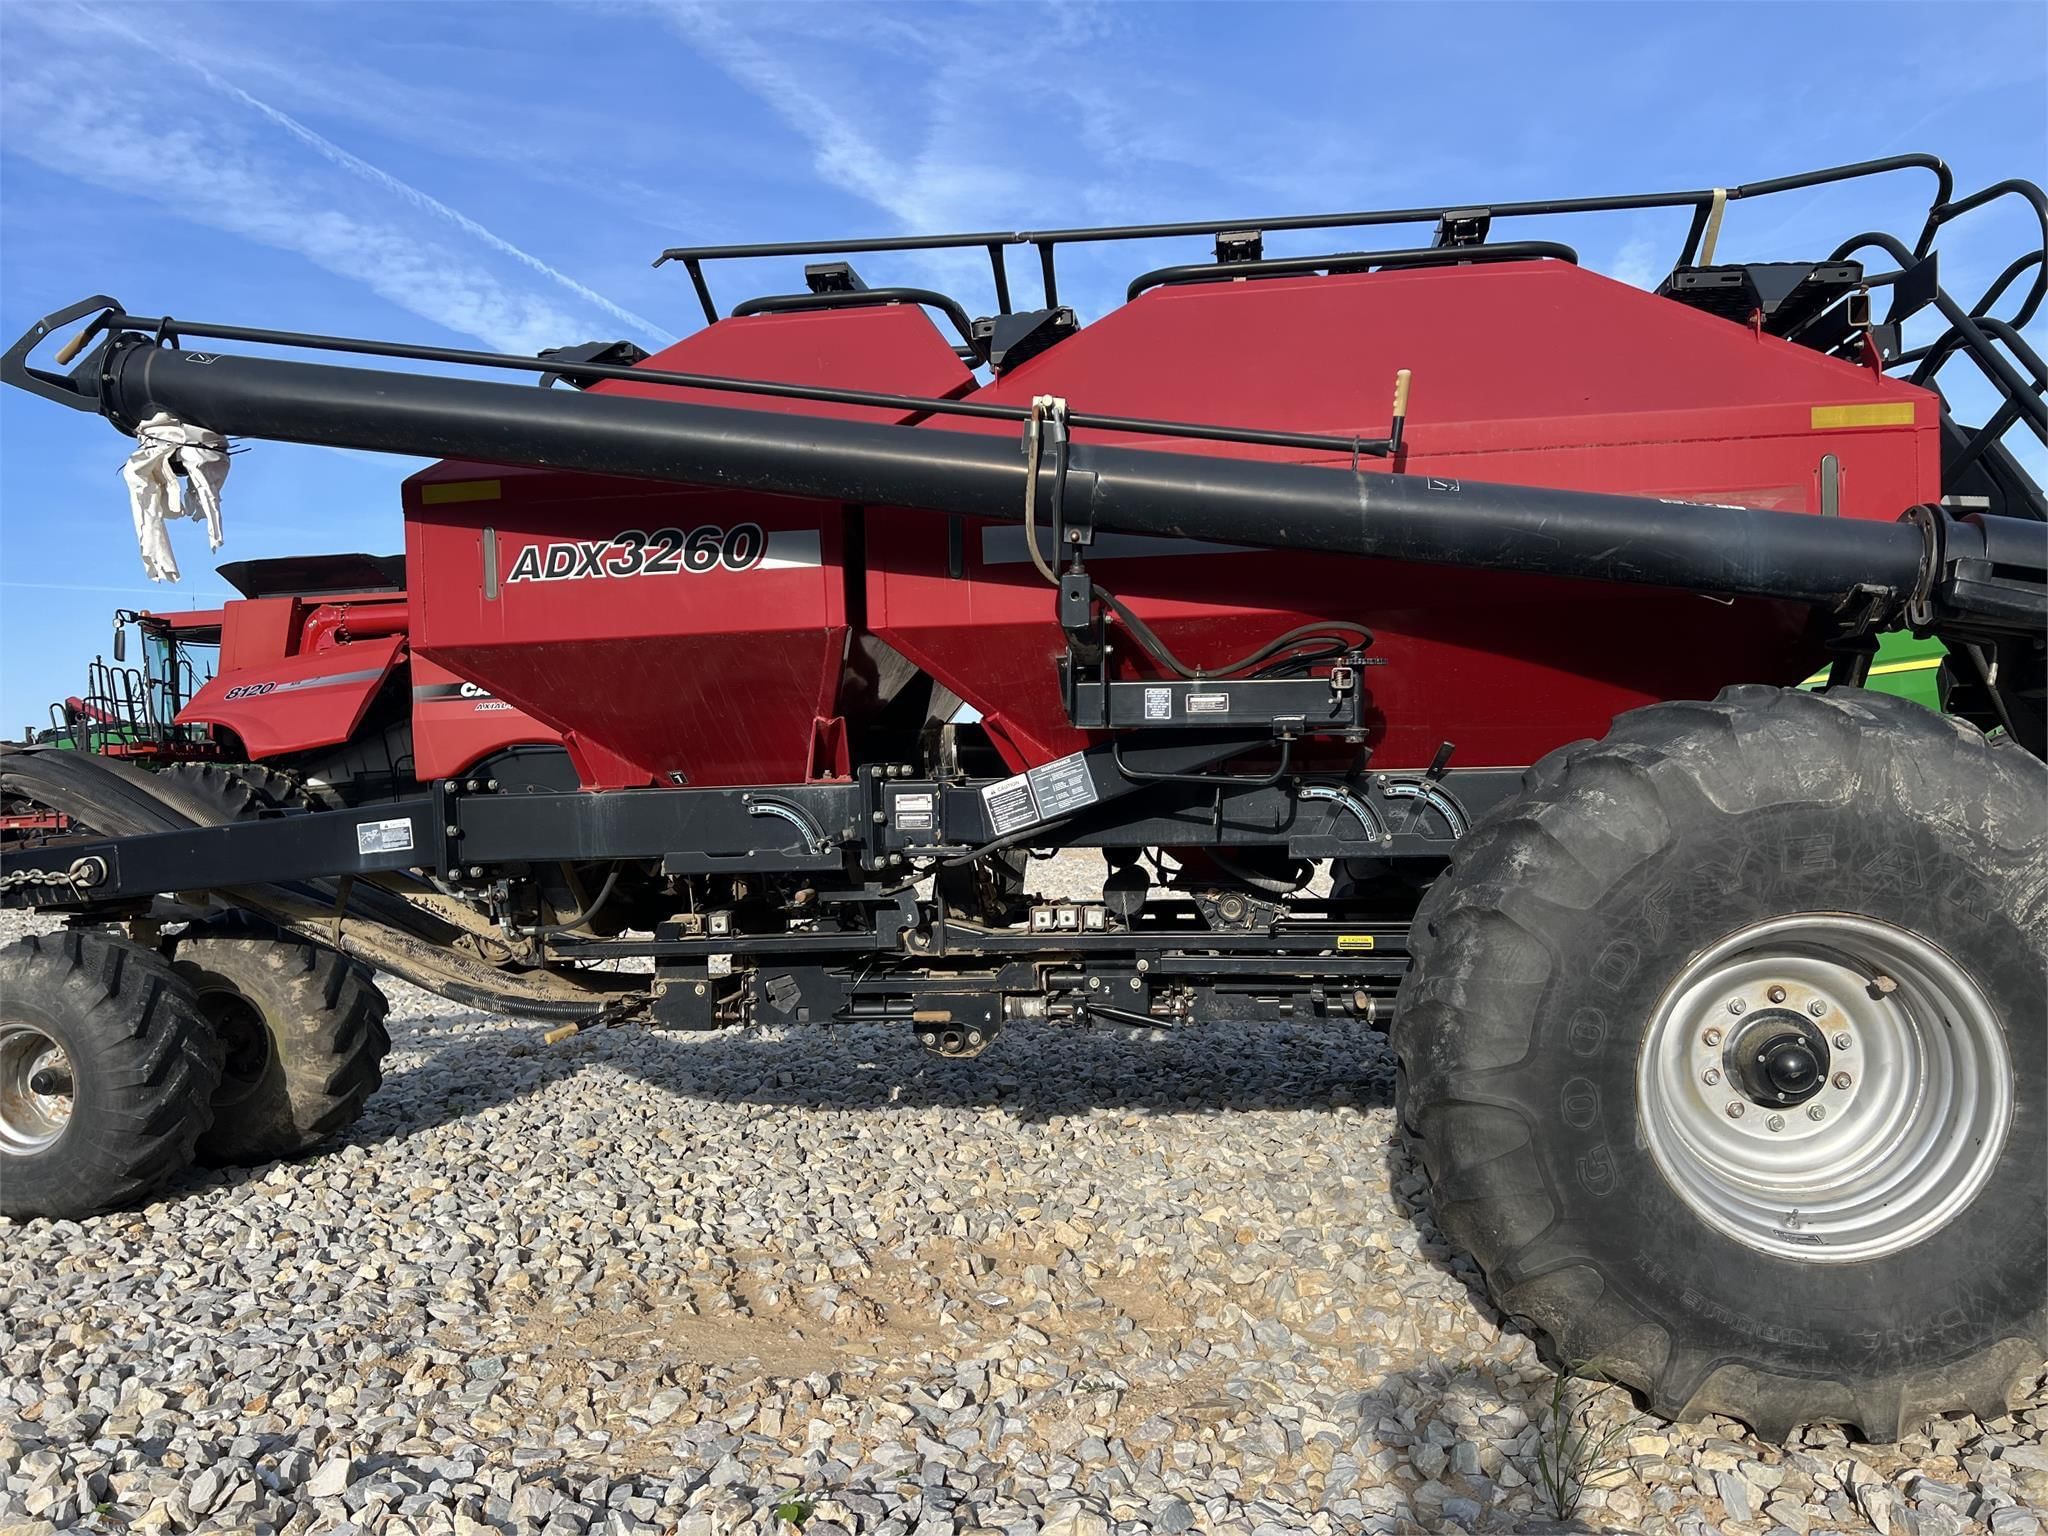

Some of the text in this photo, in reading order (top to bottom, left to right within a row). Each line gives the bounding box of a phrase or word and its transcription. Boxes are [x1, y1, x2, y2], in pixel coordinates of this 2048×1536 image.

[507, 523, 763, 583] ADX3260
[224, 681, 276, 700] 8120
[475, 702, 514, 711] AXIAL-
[1077, 1006, 1084, 1015] A
[984, 1012, 991, 1020] 4
